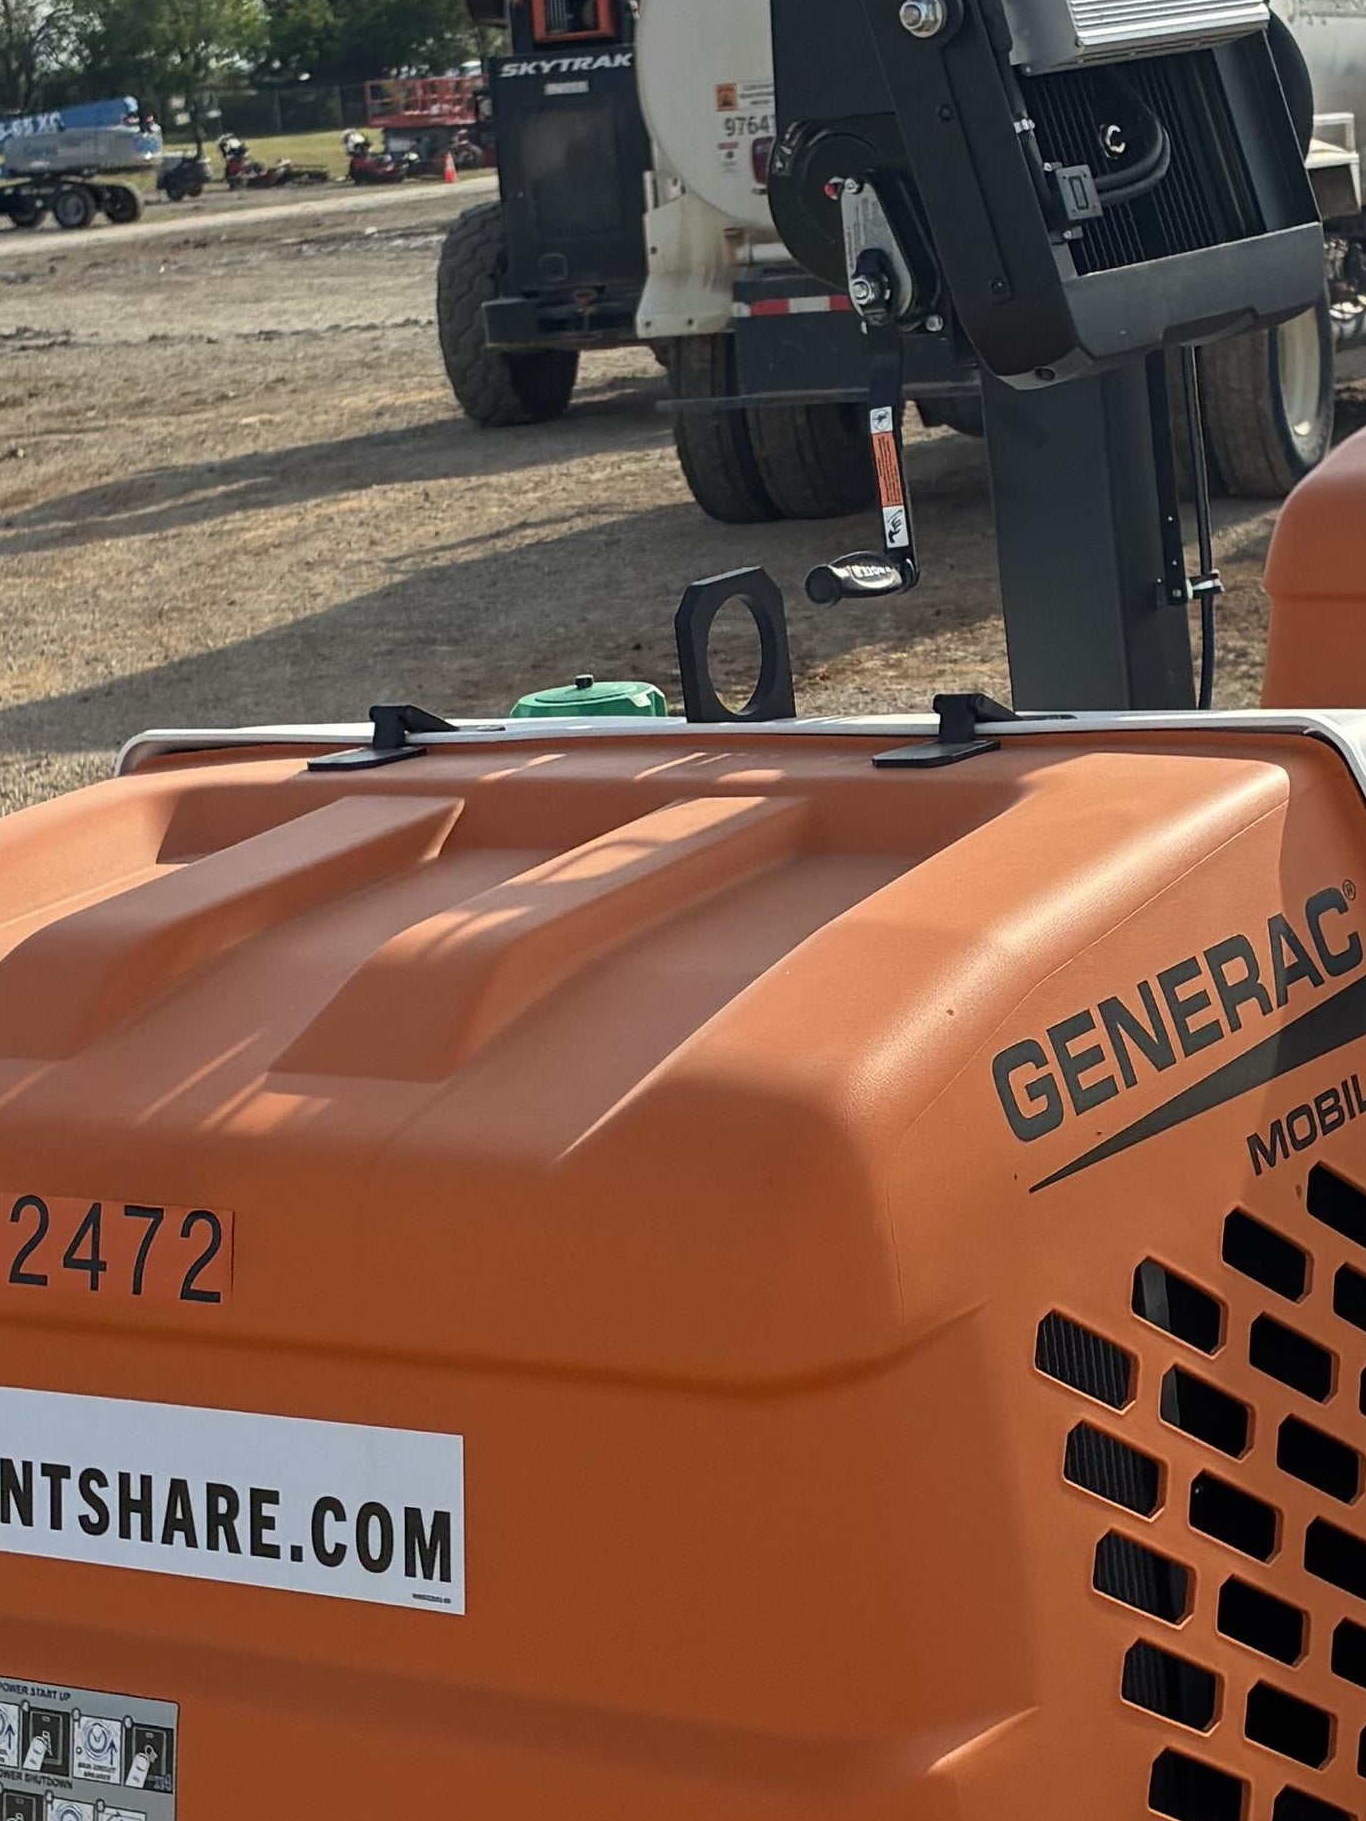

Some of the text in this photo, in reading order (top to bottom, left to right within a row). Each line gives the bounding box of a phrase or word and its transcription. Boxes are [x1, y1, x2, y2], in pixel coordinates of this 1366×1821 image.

[500, 53, 633, 78] SKYTRAK
[724, 115, 776, 137] 9764
[992, 886, 1365, 1143] GENERAC
[29, 1686, 59, 1701] START
[59, 1690, 71, 1701] UP
[23, 1771, 73, 1789] SHUTDOWN
